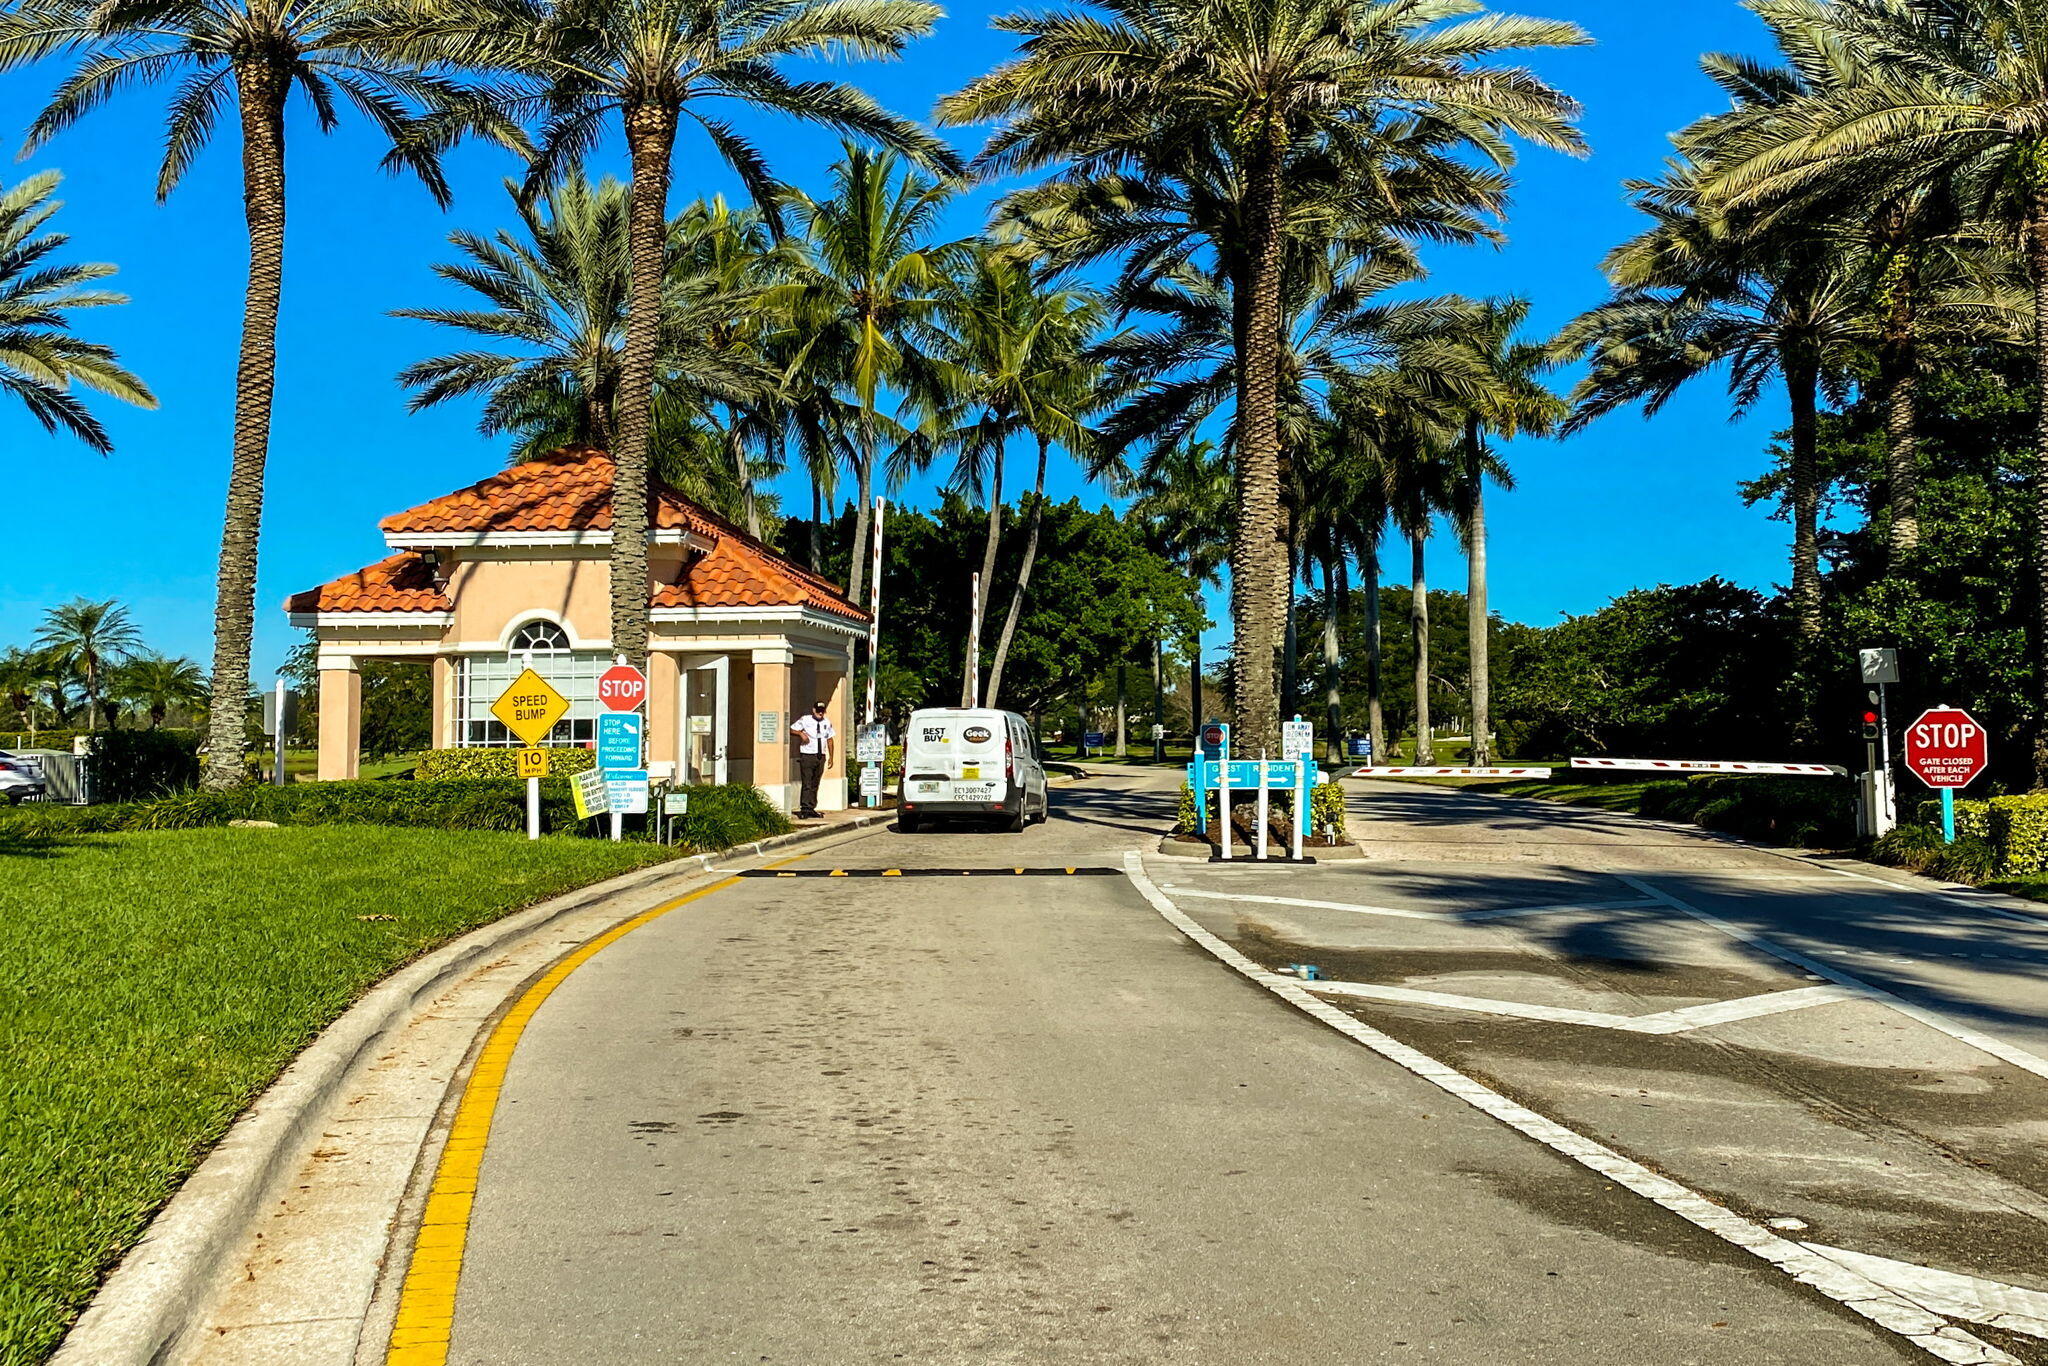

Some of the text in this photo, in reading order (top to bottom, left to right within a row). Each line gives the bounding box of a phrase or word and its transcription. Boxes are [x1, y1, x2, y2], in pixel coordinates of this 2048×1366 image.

[601, 680, 643, 698] STOP
[512, 694, 548, 707] SPEED
[515, 708, 546, 721] BUMP
[603, 719, 621, 727] STOP
[603, 727, 621, 735] HERE
[922, 727, 946, 735] BEST
[965, 729, 990, 738] Geek
[924, 735, 944, 743] BUY
[1915, 723, 1976, 749] STOP
[608, 737, 629, 745] BEFORE
[523, 752, 542, 766] 10
[605, 754, 633, 762] FORWARD
[1919, 757, 1974, 766] GATE CLOSED
[1211, 764, 1241, 773] GEST
[1252, 763, 1296, 773] RSIDENT
[1923, 766, 1970, 774] AFTER EACH
[1931, 775, 1963, 783] VEHICLE
